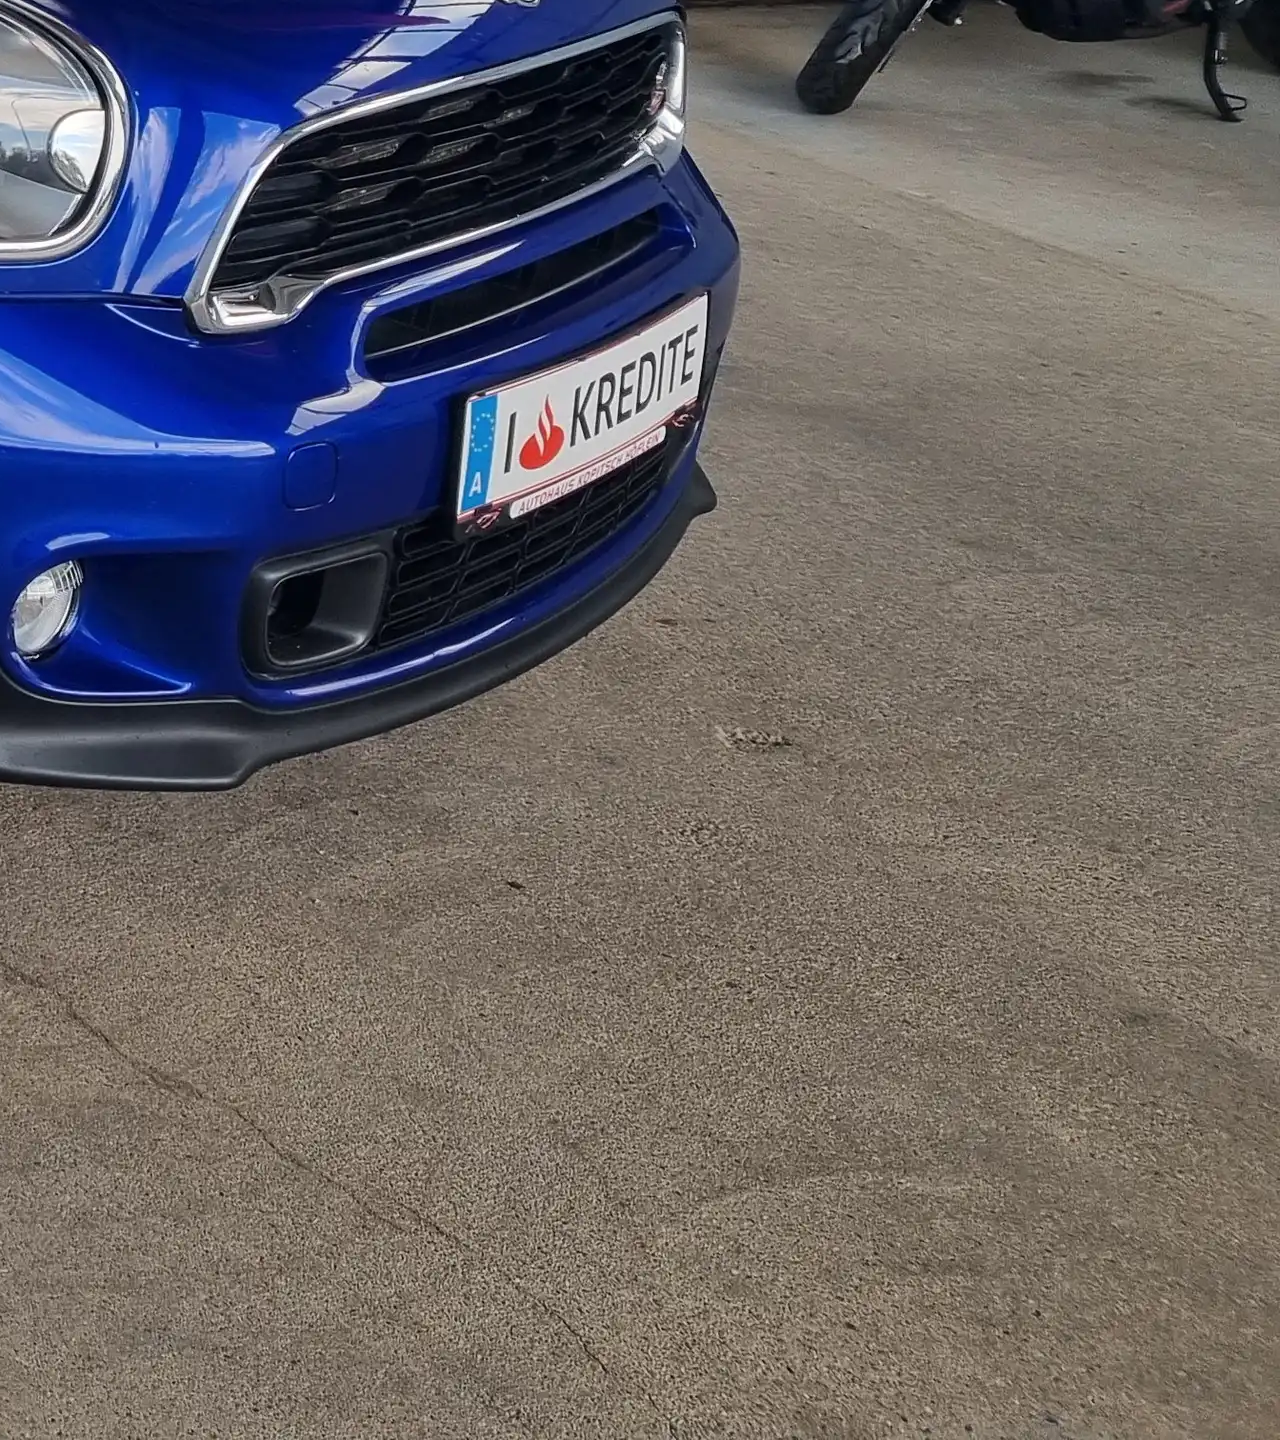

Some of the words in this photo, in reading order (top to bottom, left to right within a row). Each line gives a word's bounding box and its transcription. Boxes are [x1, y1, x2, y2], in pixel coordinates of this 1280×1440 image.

[570, 324, 699, 448] KREDITE
[468, 471, 482, 498] A
[518, 479, 576, 515] AUTOHAUS
